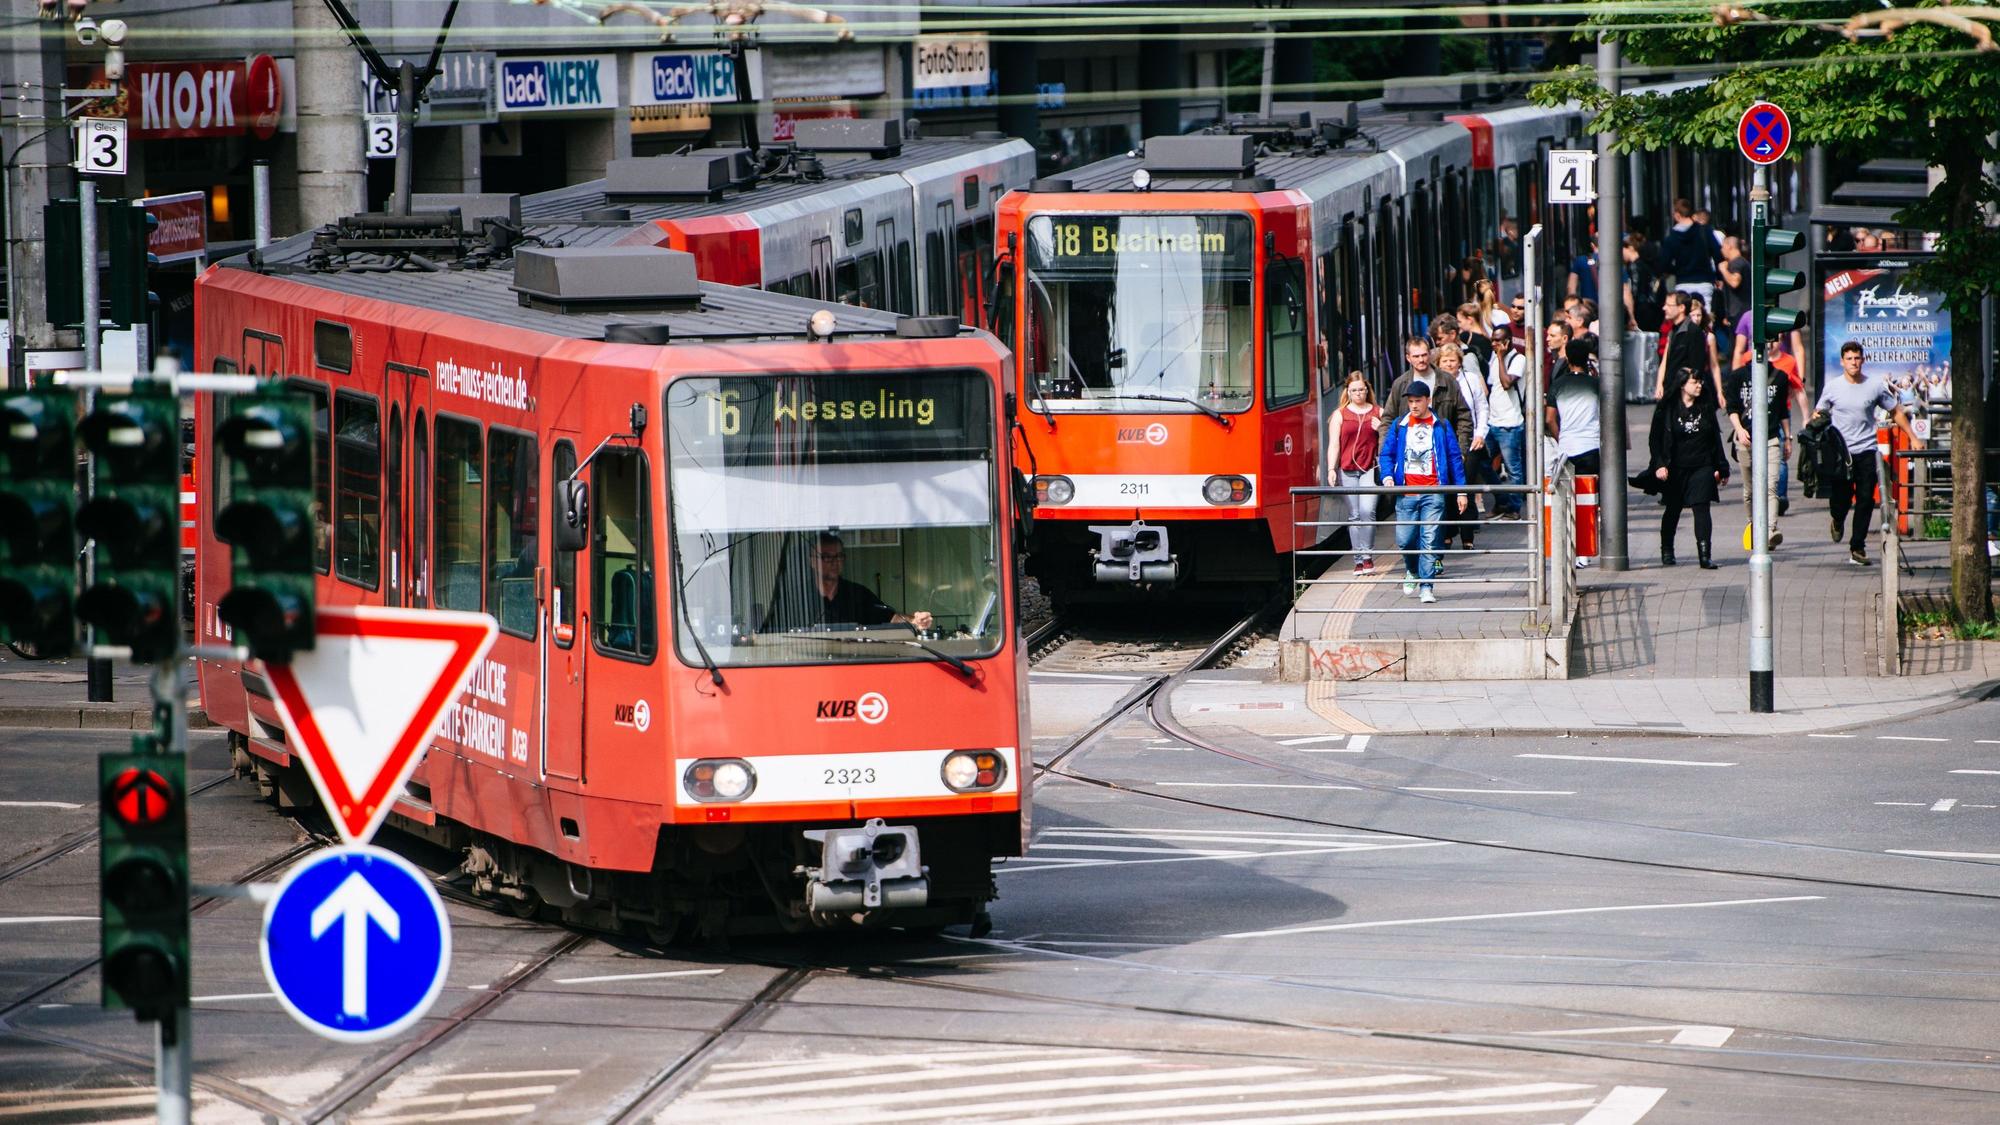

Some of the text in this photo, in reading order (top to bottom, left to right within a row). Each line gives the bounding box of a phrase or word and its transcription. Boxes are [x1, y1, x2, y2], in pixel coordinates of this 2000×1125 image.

[918, 43, 986, 75] FotoStudio
[141, 70, 236, 130] KIOSK
[94, 121, 117, 132] Gleis
[93, 134, 118, 167] 3
[375, 127, 394, 154] 3
[1558, 156, 1579, 164] Gleis
[1560, 167, 1580, 196] 4
[1054, 224, 1226, 256] 18 Buchheim
[1825, 272, 1854, 295] NEU!
[1858, 309, 1929, 318] LAND
[1867, 322, 1884, 332] NEUE
[1862, 336, 1932, 348] ACHTERBAHNEN
[1866, 351, 1928, 362] WELTREKORDE
[436, 357, 527, 410] rente-muss-reichen.de
[705, 388, 935, 436] 16 Wesseling
[1117, 428, 1145, 441] KVB
[1120, 483, 1150, 495] 2311
[615, 704, 634, 722] KVB
[816, 700, 857, 718] KVB
[462, 698, 506, 760] STÄRKEN!
[511, 728, 528, 762] DGB
[824, 768, 877, 785] 2323
